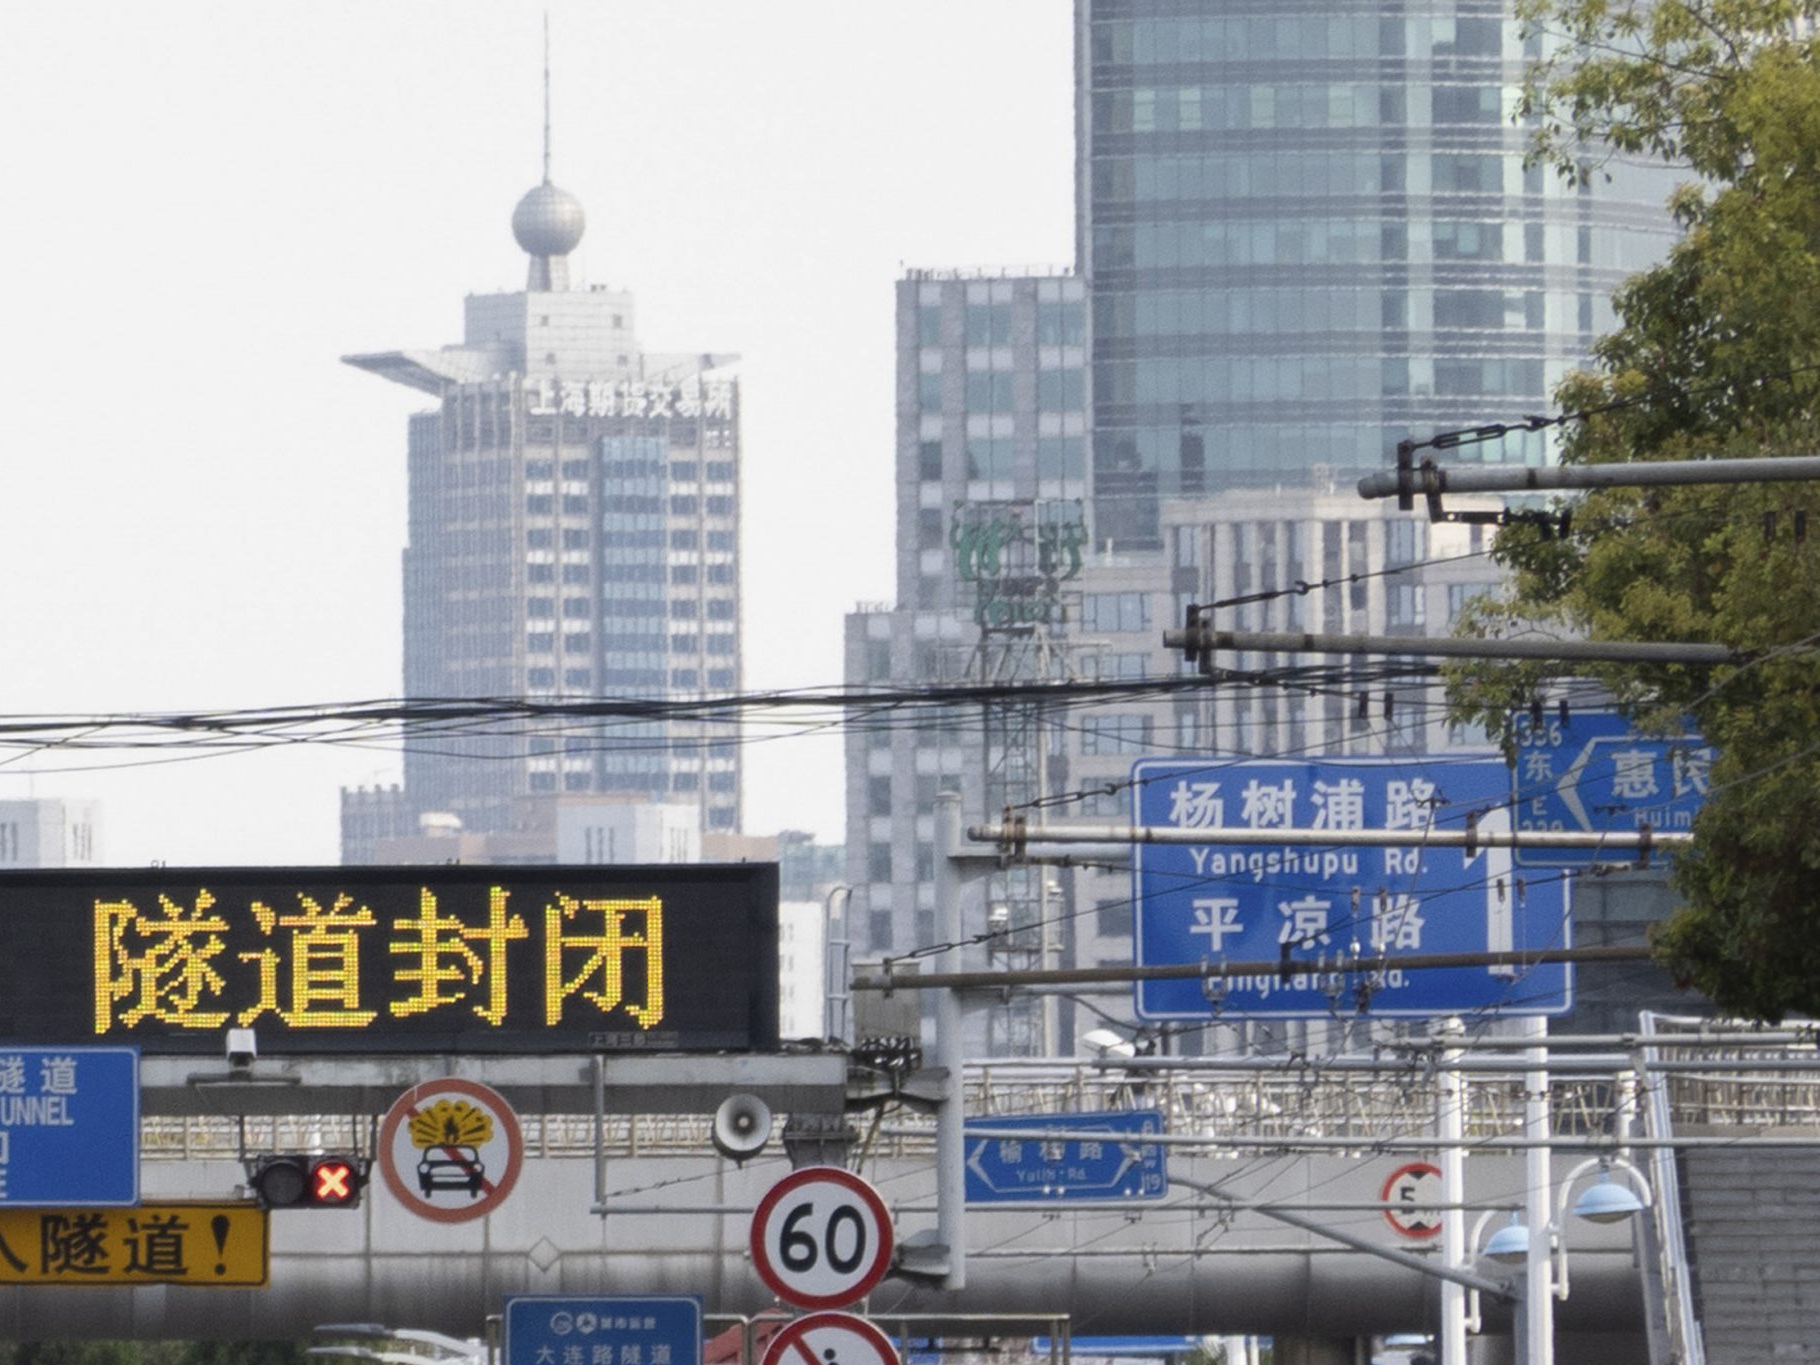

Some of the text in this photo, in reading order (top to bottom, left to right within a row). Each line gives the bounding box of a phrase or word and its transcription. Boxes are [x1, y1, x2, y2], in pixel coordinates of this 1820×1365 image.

[1524, 750, 1553, 781] 东
[1169, 778, 1436, 830] 杨树浦路
[1189, 848, 1428, 882] Yangshupu Rd.
[1190, 895, 1426, 951] 平凉路
[94, 887, 664, 1035] 隧道封闭
[780, 1202, 867, 1275] 60
[535, 1344, 672, 1365] 大连路隧道
